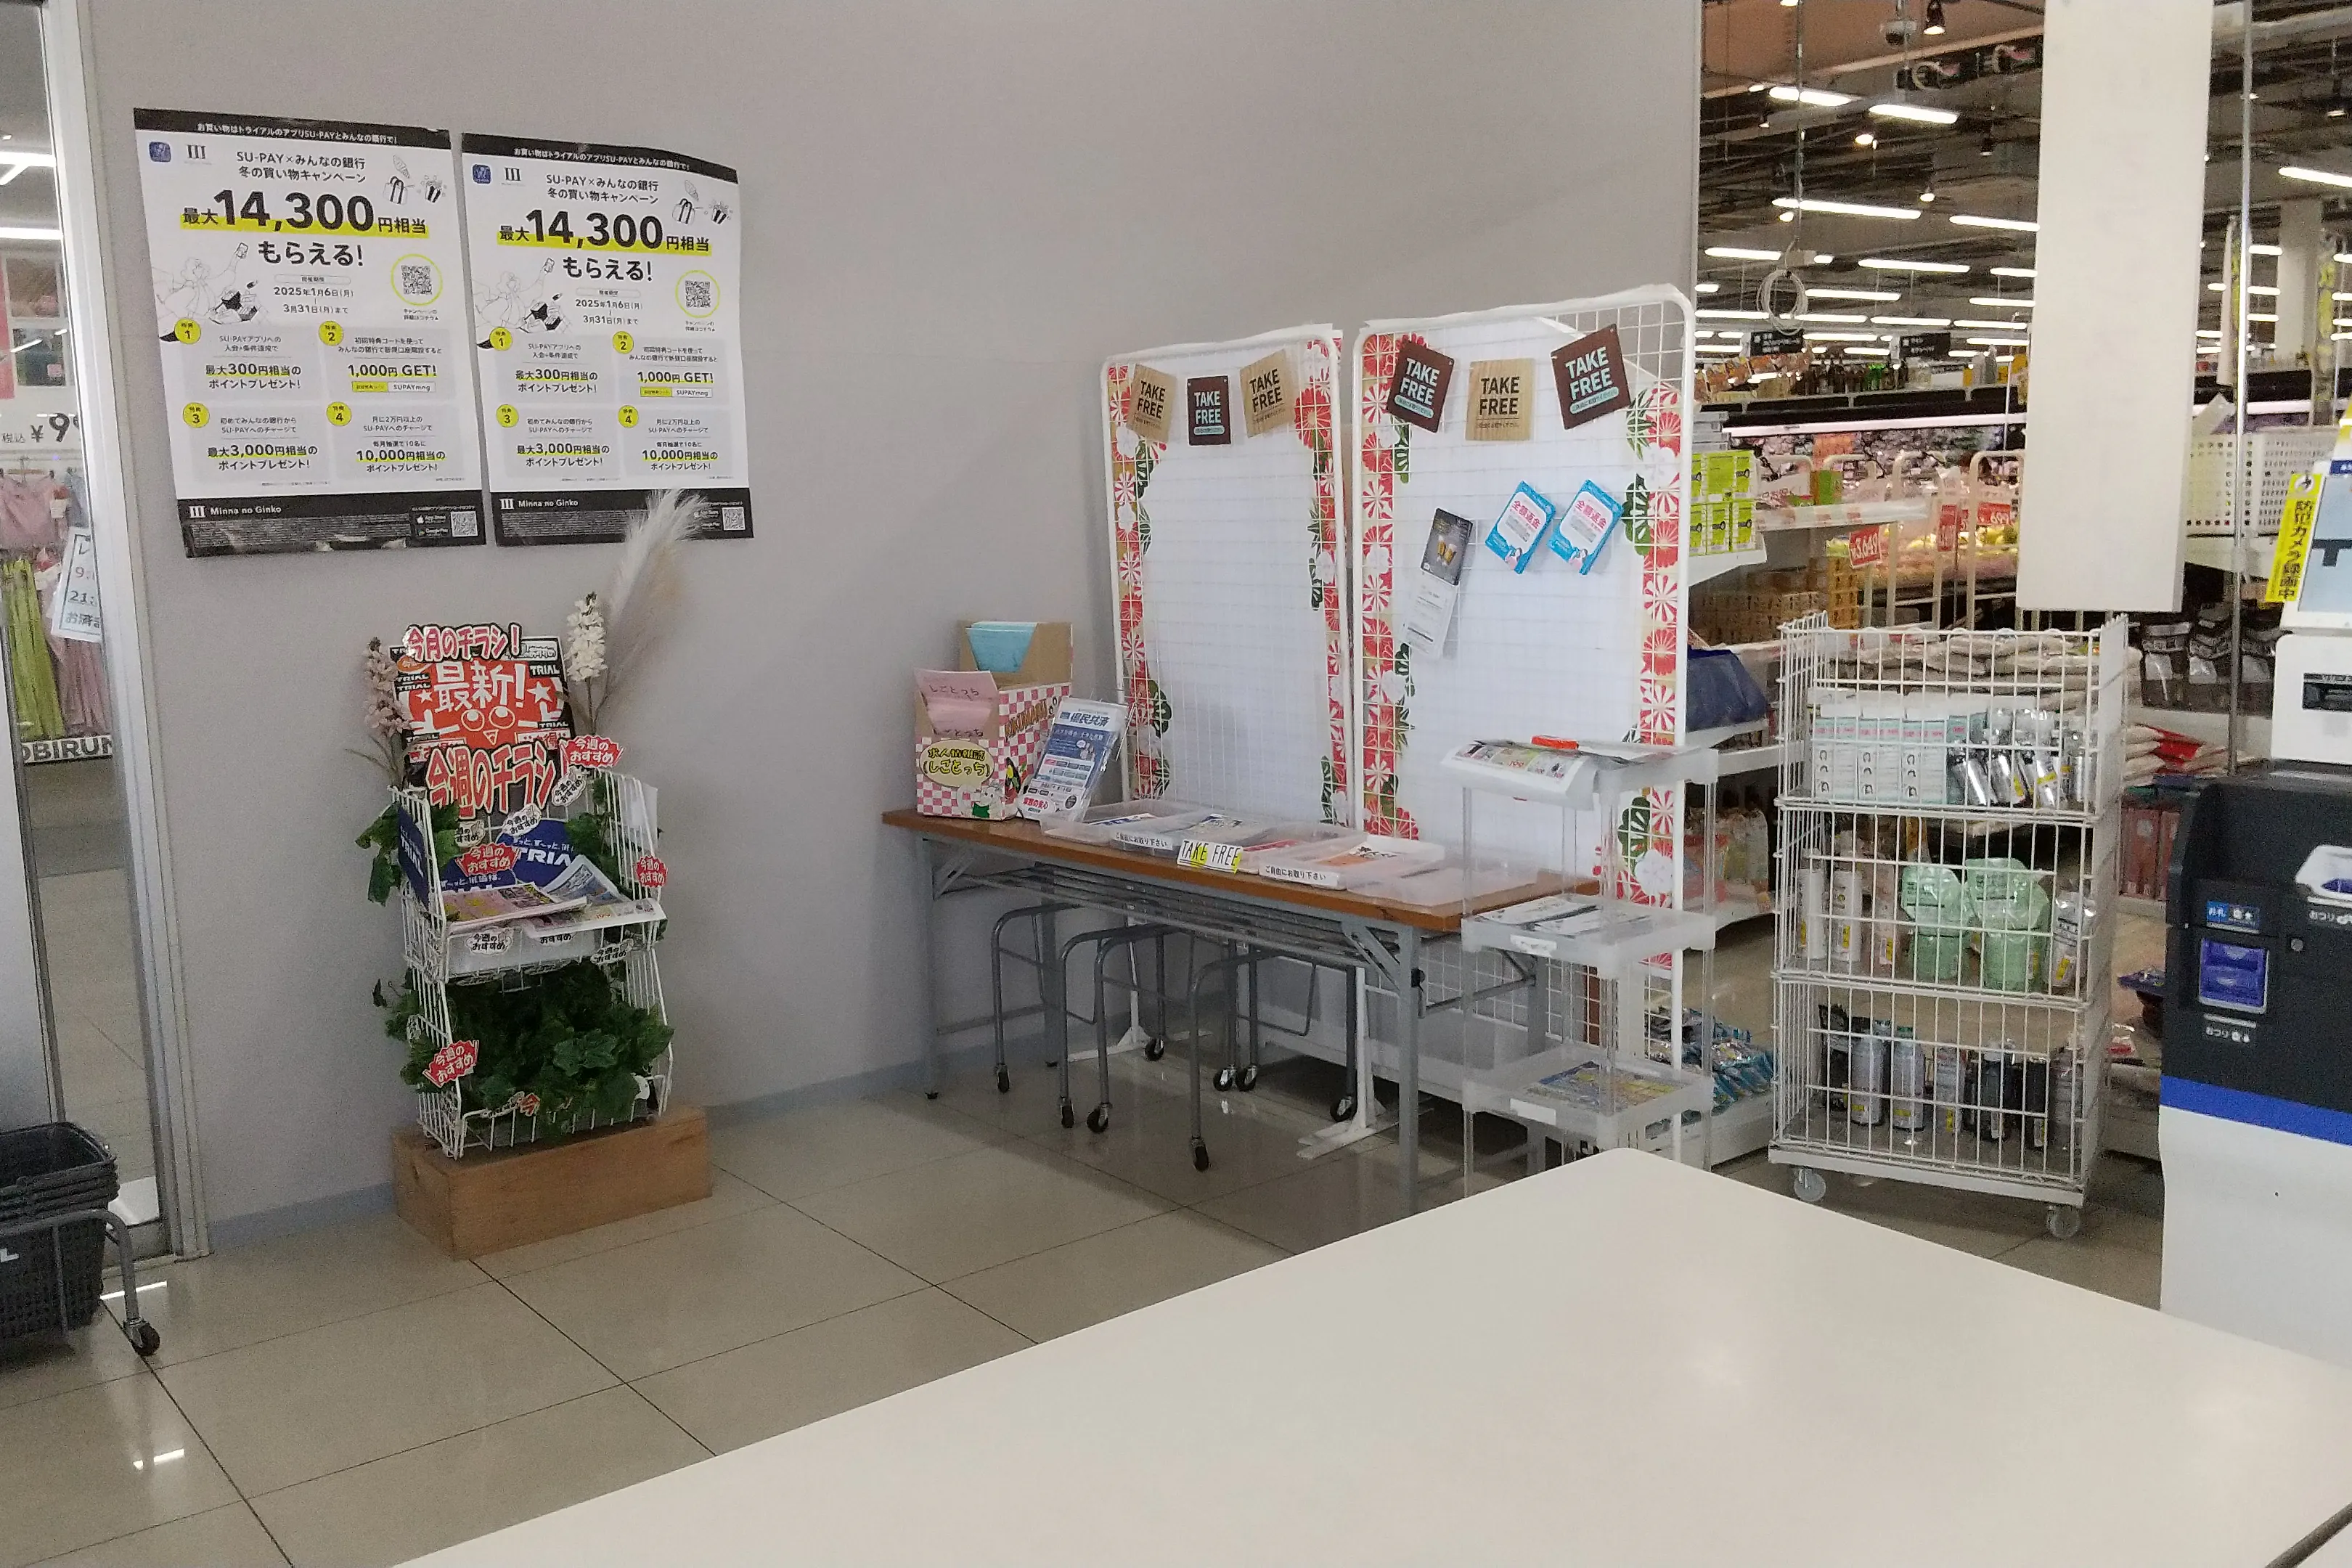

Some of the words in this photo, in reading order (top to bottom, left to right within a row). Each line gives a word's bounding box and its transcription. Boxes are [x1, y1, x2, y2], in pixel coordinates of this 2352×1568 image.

[239, 166, 366, 182] 冬の買い物キャンペーン
[547, 188, 658, 204] 冬の買い物キャンペーン
[184, 189, 426, 234] 最大14,300円相当
[499, 209, 710, 252] 最大14,300円相当
[184, 330, 192, 340] 1
[327, 332, 336, 341] 2
[498, 338, 504, 347] 1
[620, 341, 626, 350] 2
[1565, 346, 1609, 379] TAKE
[205, 364, 301, 376] 最大300円相当の
[348, 364, 398, 377] 1,000円
[402, 364, 437, 376] GET!
[515, 369, 598, 381] 最大300円相当の
[1406, 357, 1440, 387] TAKE
[208, 378, 301, 390] ポイントプレゼント!
[637, 372, 680, 383] 1,000円
[684, 372, 714, 383] GET!
[1249, 369, 1281, 394] TAKE
[1569, 368, 1613, 400] FREE
[518, 383, 597, 393] ポイントプレゼント!
[1140, 380, 1166, 402] TAKE
[1400, 377, 1434, 405] FREE
[1481, 376, 1521, 394] TAKE
[1193, 391, 1221, 407] TAKE
[1251, 387, 1283, 412] FREE
[1137, 398, 1164, 419] FREE
[1479, 398, 1519, 415] FREE
[192, 414, 200, 423] 3
[335, 412, 343, 422] 4
[504, 415, 511, 424] 3
[1195, 409, 1222, 425] FREE
[208, 444, 318, 457] 最大3,000円相当の
[517, 443, 610, 455] 最大3,000円相当の
[642, 449, 718, 461] 10,000円相当の
[356, 450, 446, 462] 10,000円相当の
[526, 457, 603, 467] ポイントプレゼント!
[219, 460, 310, 470] ポイントプレゼント!
[367, 464, 438, 473] ポイントプレゼント!
[650, 462, 711, 471] ポイントプレゼント!
[555, 499, 579, 507] Ginko
[211, 507, 239, 515] Minna
[256, 505, 282, 515] Ginko
[529, 664, 560, 676] TRIAL
[434, 660, 526, 713] 最新!
[575, 738, 609, 751] 今週の
[570, 751, 614, 762] おすすめ
[426, 742, 556, 820] 今週のチラシ
[507, 814, 528, 825] 今週の
[510, 817, 539, 834] おすすめ
[1116, 833, 1167, 847] ご自由にお取り下さい
[470, 846, 505, 858] 今週の
[513, 846, 572, 866] TRIA
[1182, 840, 1209, 861] TAKE
[1212, 845, 1241, 866] FREE
[467, 858, 510, 873] おすすめ
[640, 858, 660, 870] 今週の
[640, 871, 665, 883] おすすめ
[1265, 865, 1326, 880] ご自由にお取り下さい
[436, 1045, 465, 1066] 今週の
[436, 1053, 474, 1083] おすすめ
